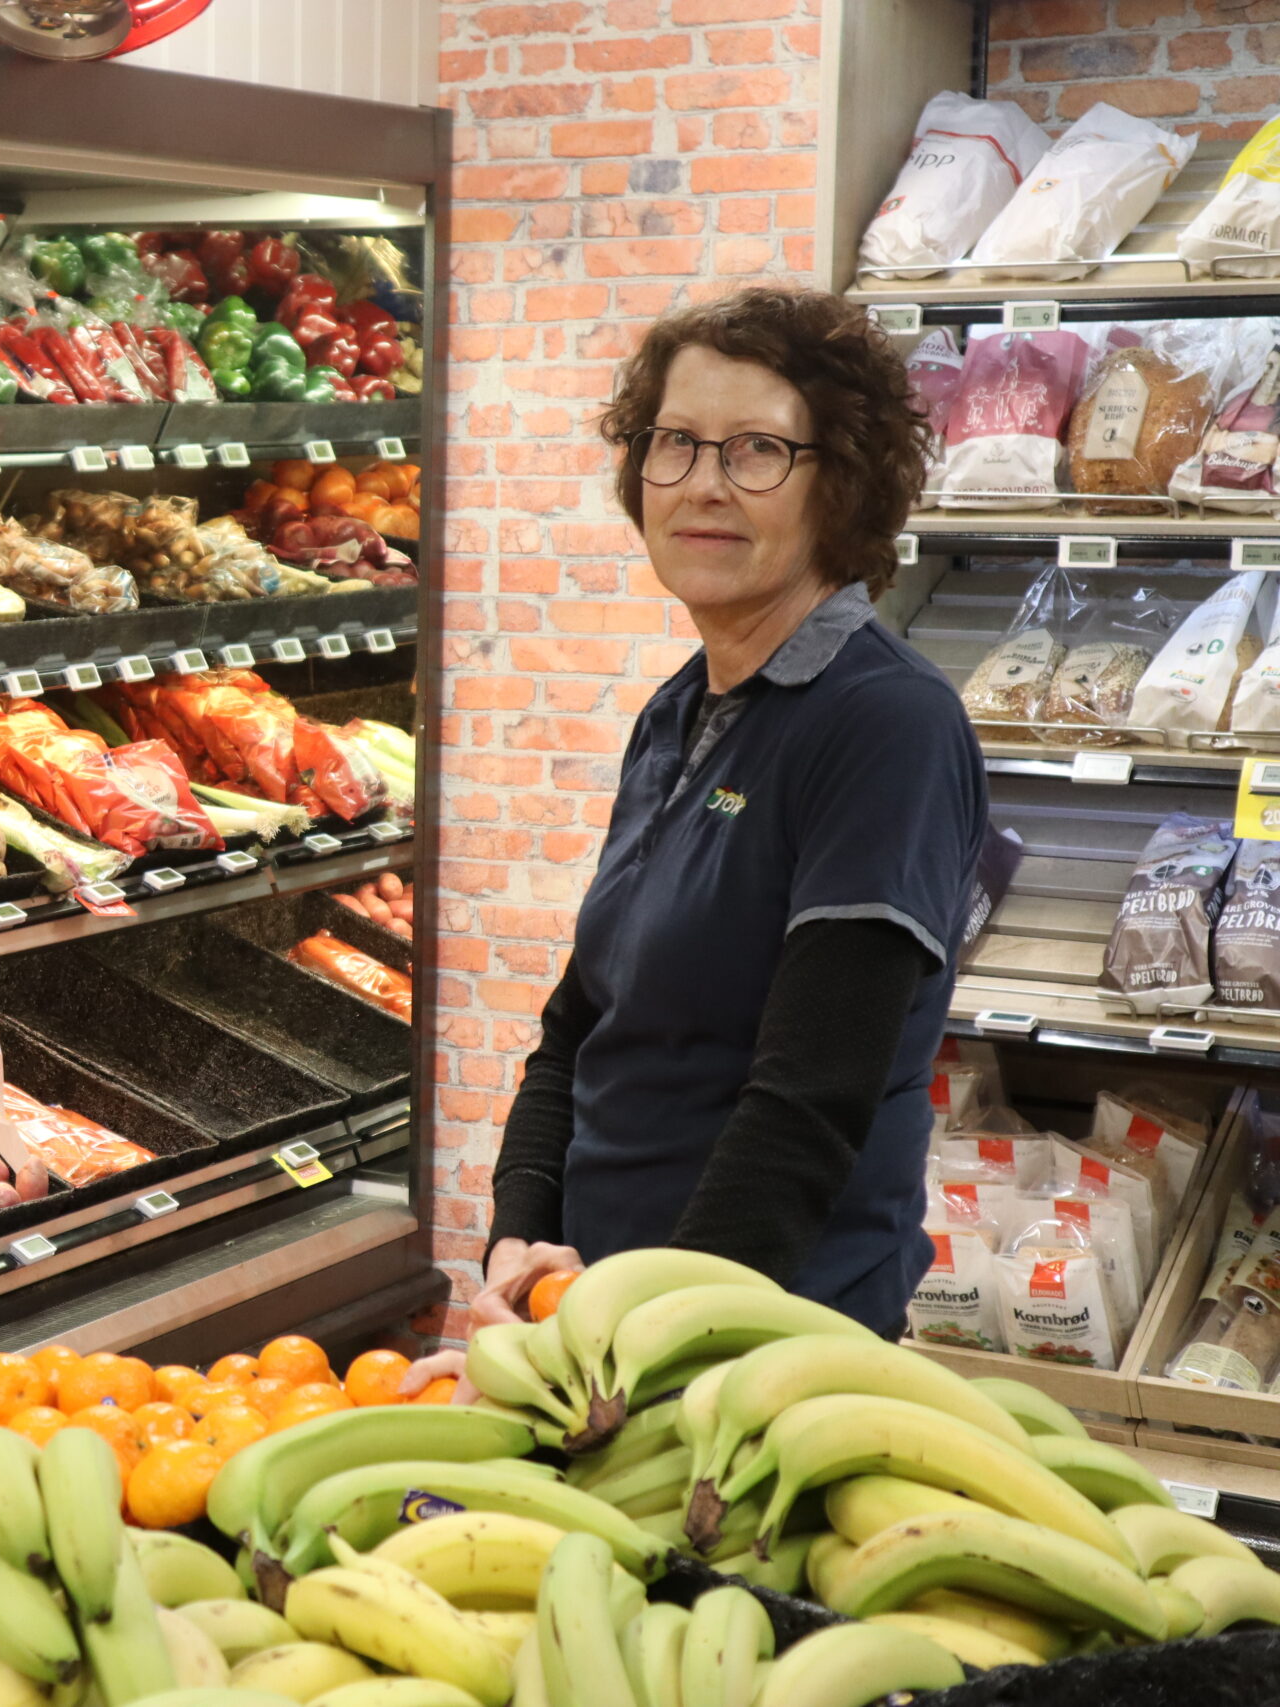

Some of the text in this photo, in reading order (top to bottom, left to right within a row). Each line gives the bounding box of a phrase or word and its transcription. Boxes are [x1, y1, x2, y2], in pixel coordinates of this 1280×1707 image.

[906, 149, 955, 168] ipp
[1222, 988, 1264, 1002] PELTBRØD
[1013, 1306, 1090, 1326] Kornbrød
